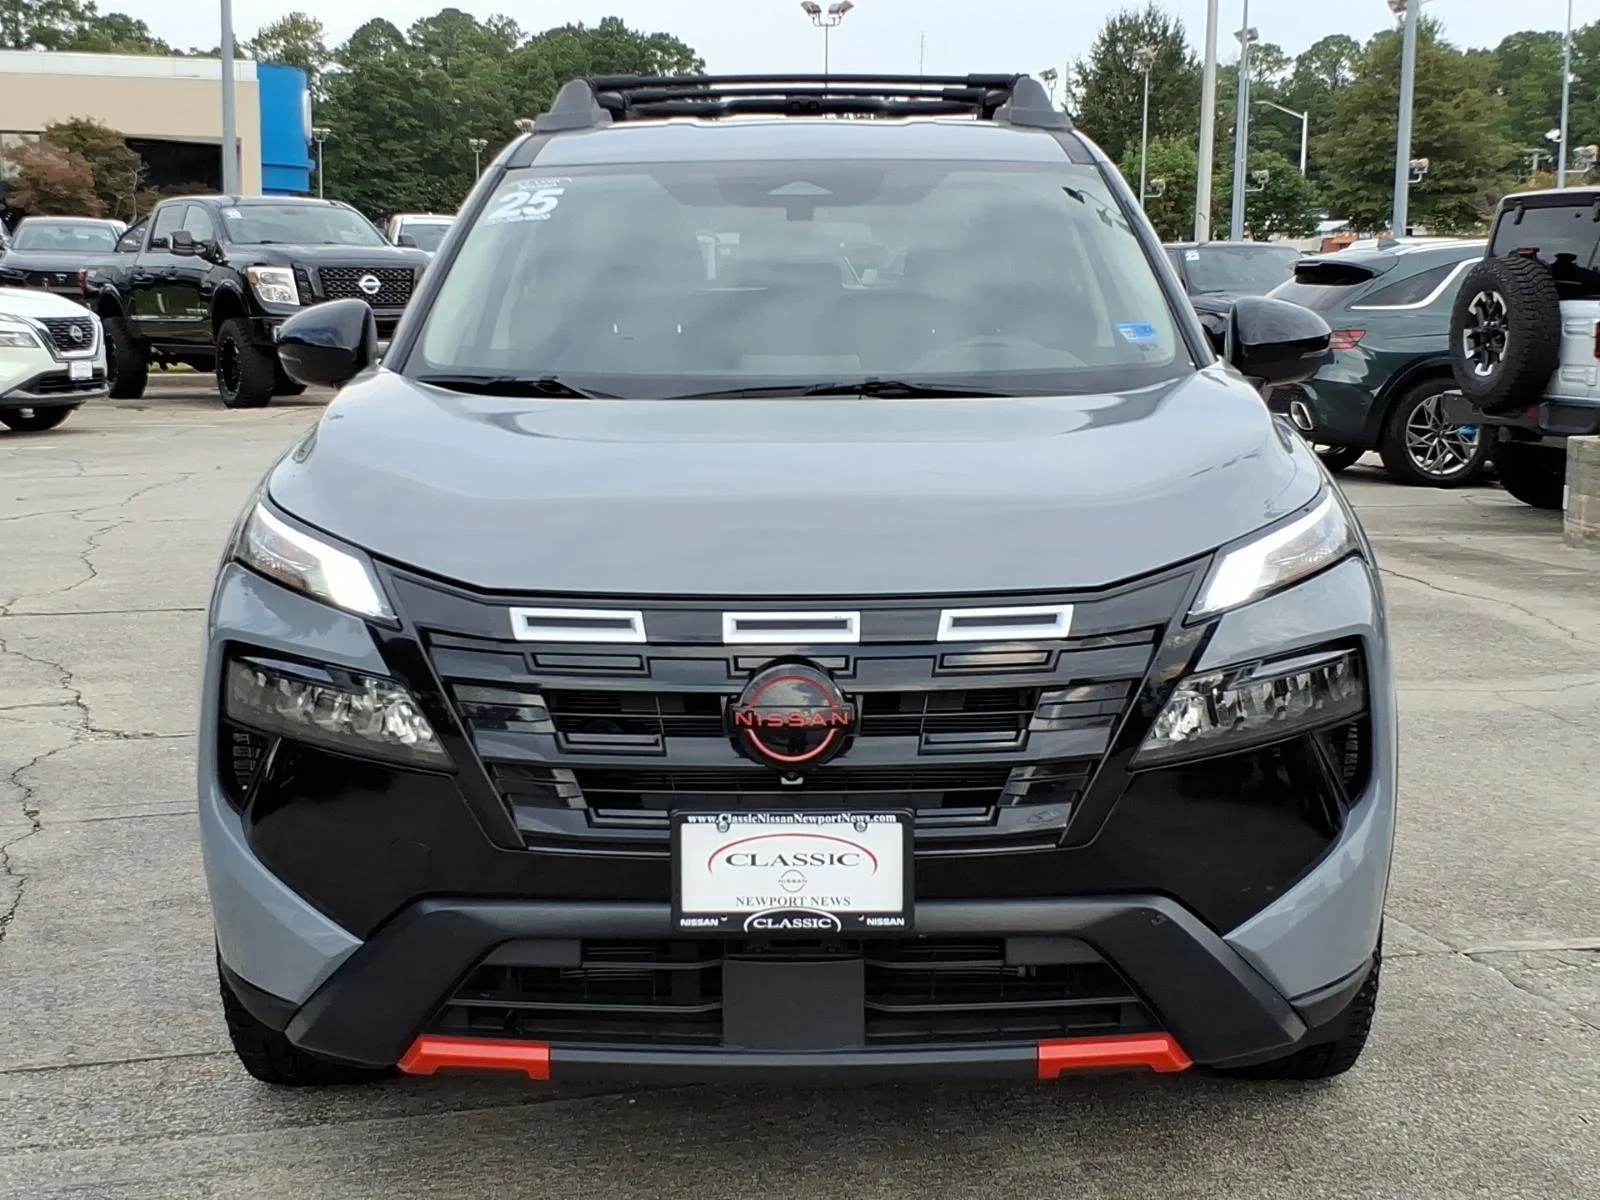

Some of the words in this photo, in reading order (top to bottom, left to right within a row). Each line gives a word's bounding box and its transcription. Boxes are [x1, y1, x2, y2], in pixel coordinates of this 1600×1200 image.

[487, 188, 564, 218] 25
[735, 711, 849, 726] NISSAN
[687, 813, 897, 825] www.ClassicNissanNewportNews.com
[725, 852, 860, 867] CLASSIC
[735, 896, 807, 907] NEWPORT
[810, 896, 851, 907] NEWS
[680, 918, 719, 927] NISSAN
[753, 918, 832, 929] CLASSIC
[866, 918, 905, 926] NISSAN
